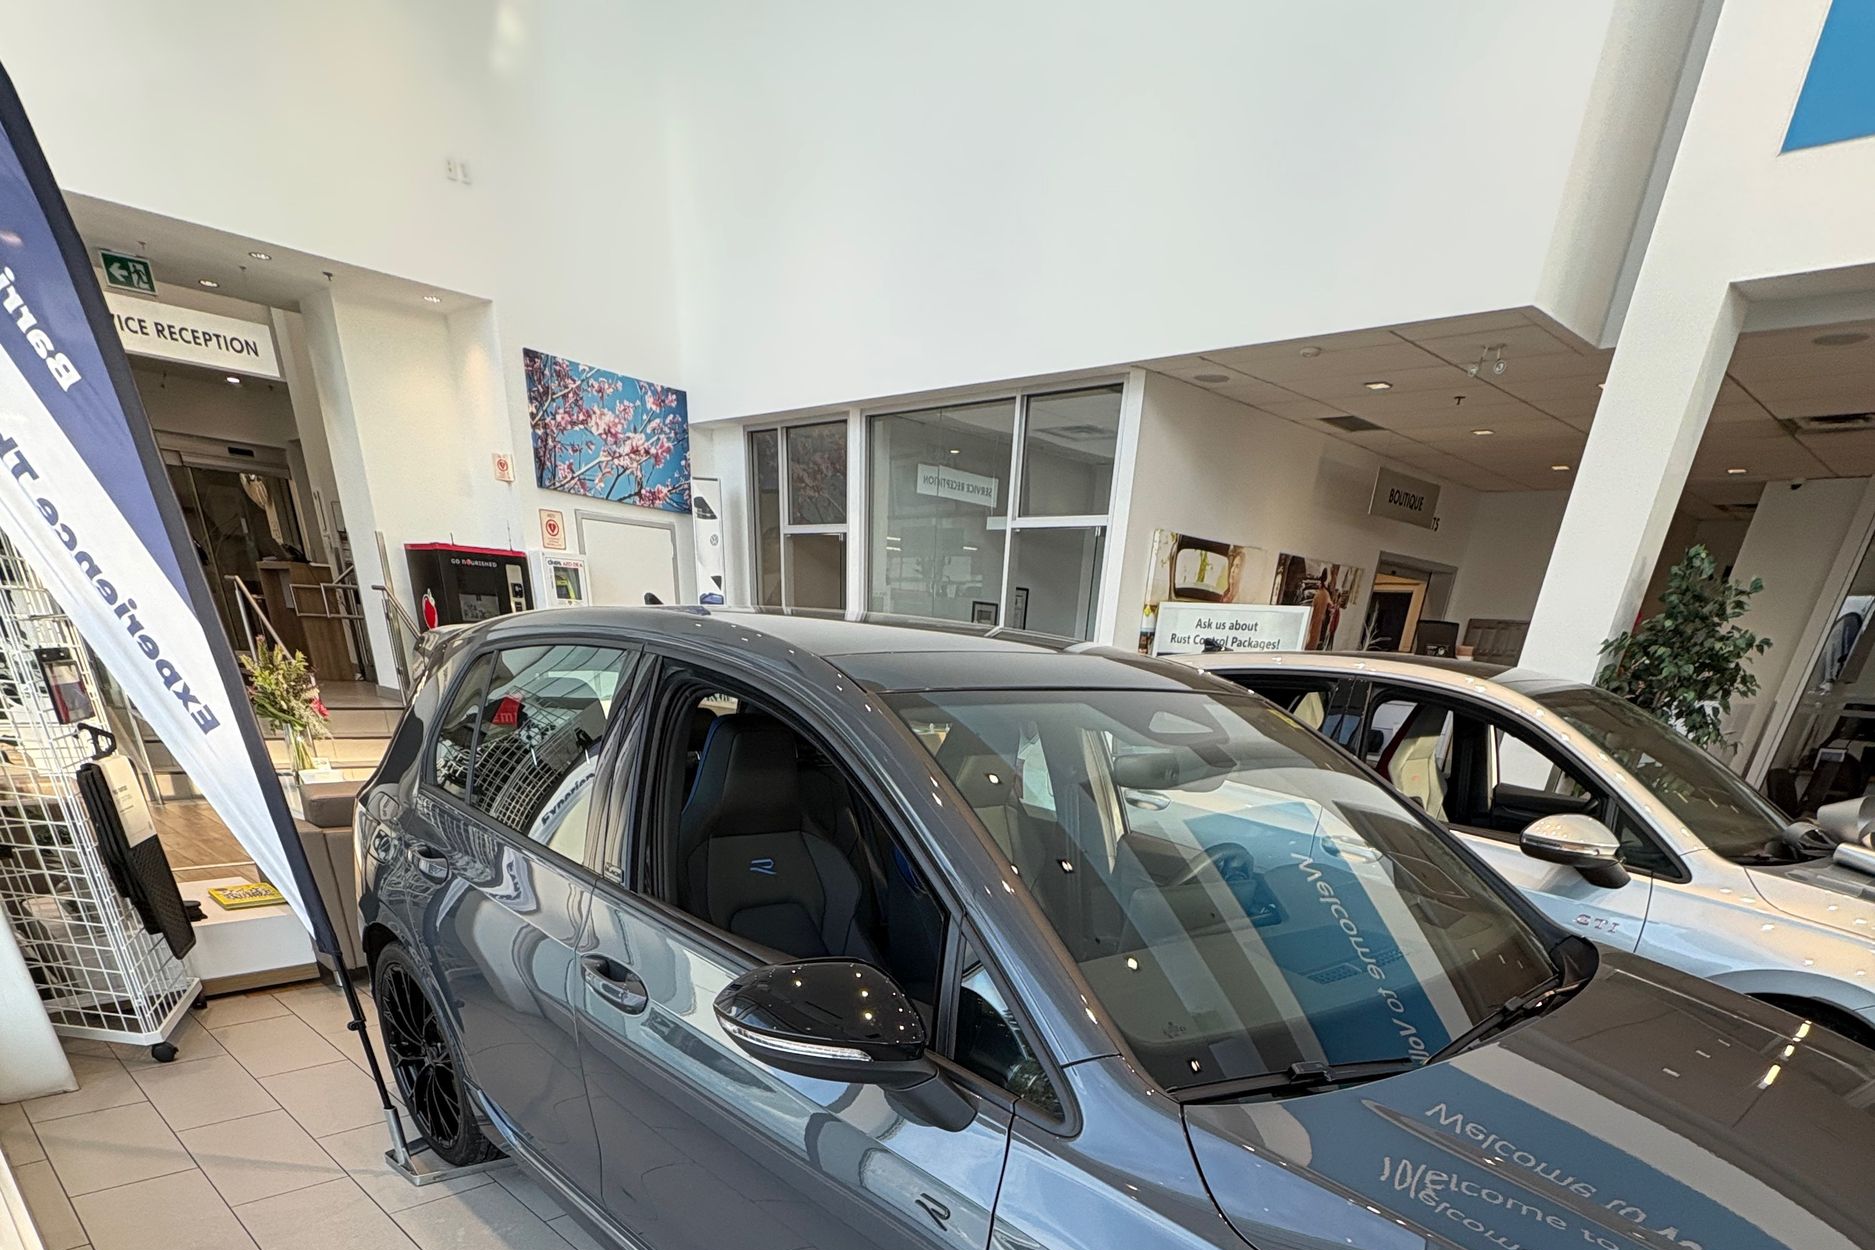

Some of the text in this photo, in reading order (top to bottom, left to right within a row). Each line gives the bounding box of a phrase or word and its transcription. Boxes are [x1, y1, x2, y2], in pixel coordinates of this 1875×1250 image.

[153, 321, 259, 357] RECEPTION
[1388, 488, 1425, 512] BOUTIQUE
[1195, 618, 1258, 632] Ask us about
[1170, 633, 1191, 645] Rust
[1231, 636, 1281, 650] Packages!
[1576, 913, 1620, 933] GTI
[914, 1192, 951, 1231] R
